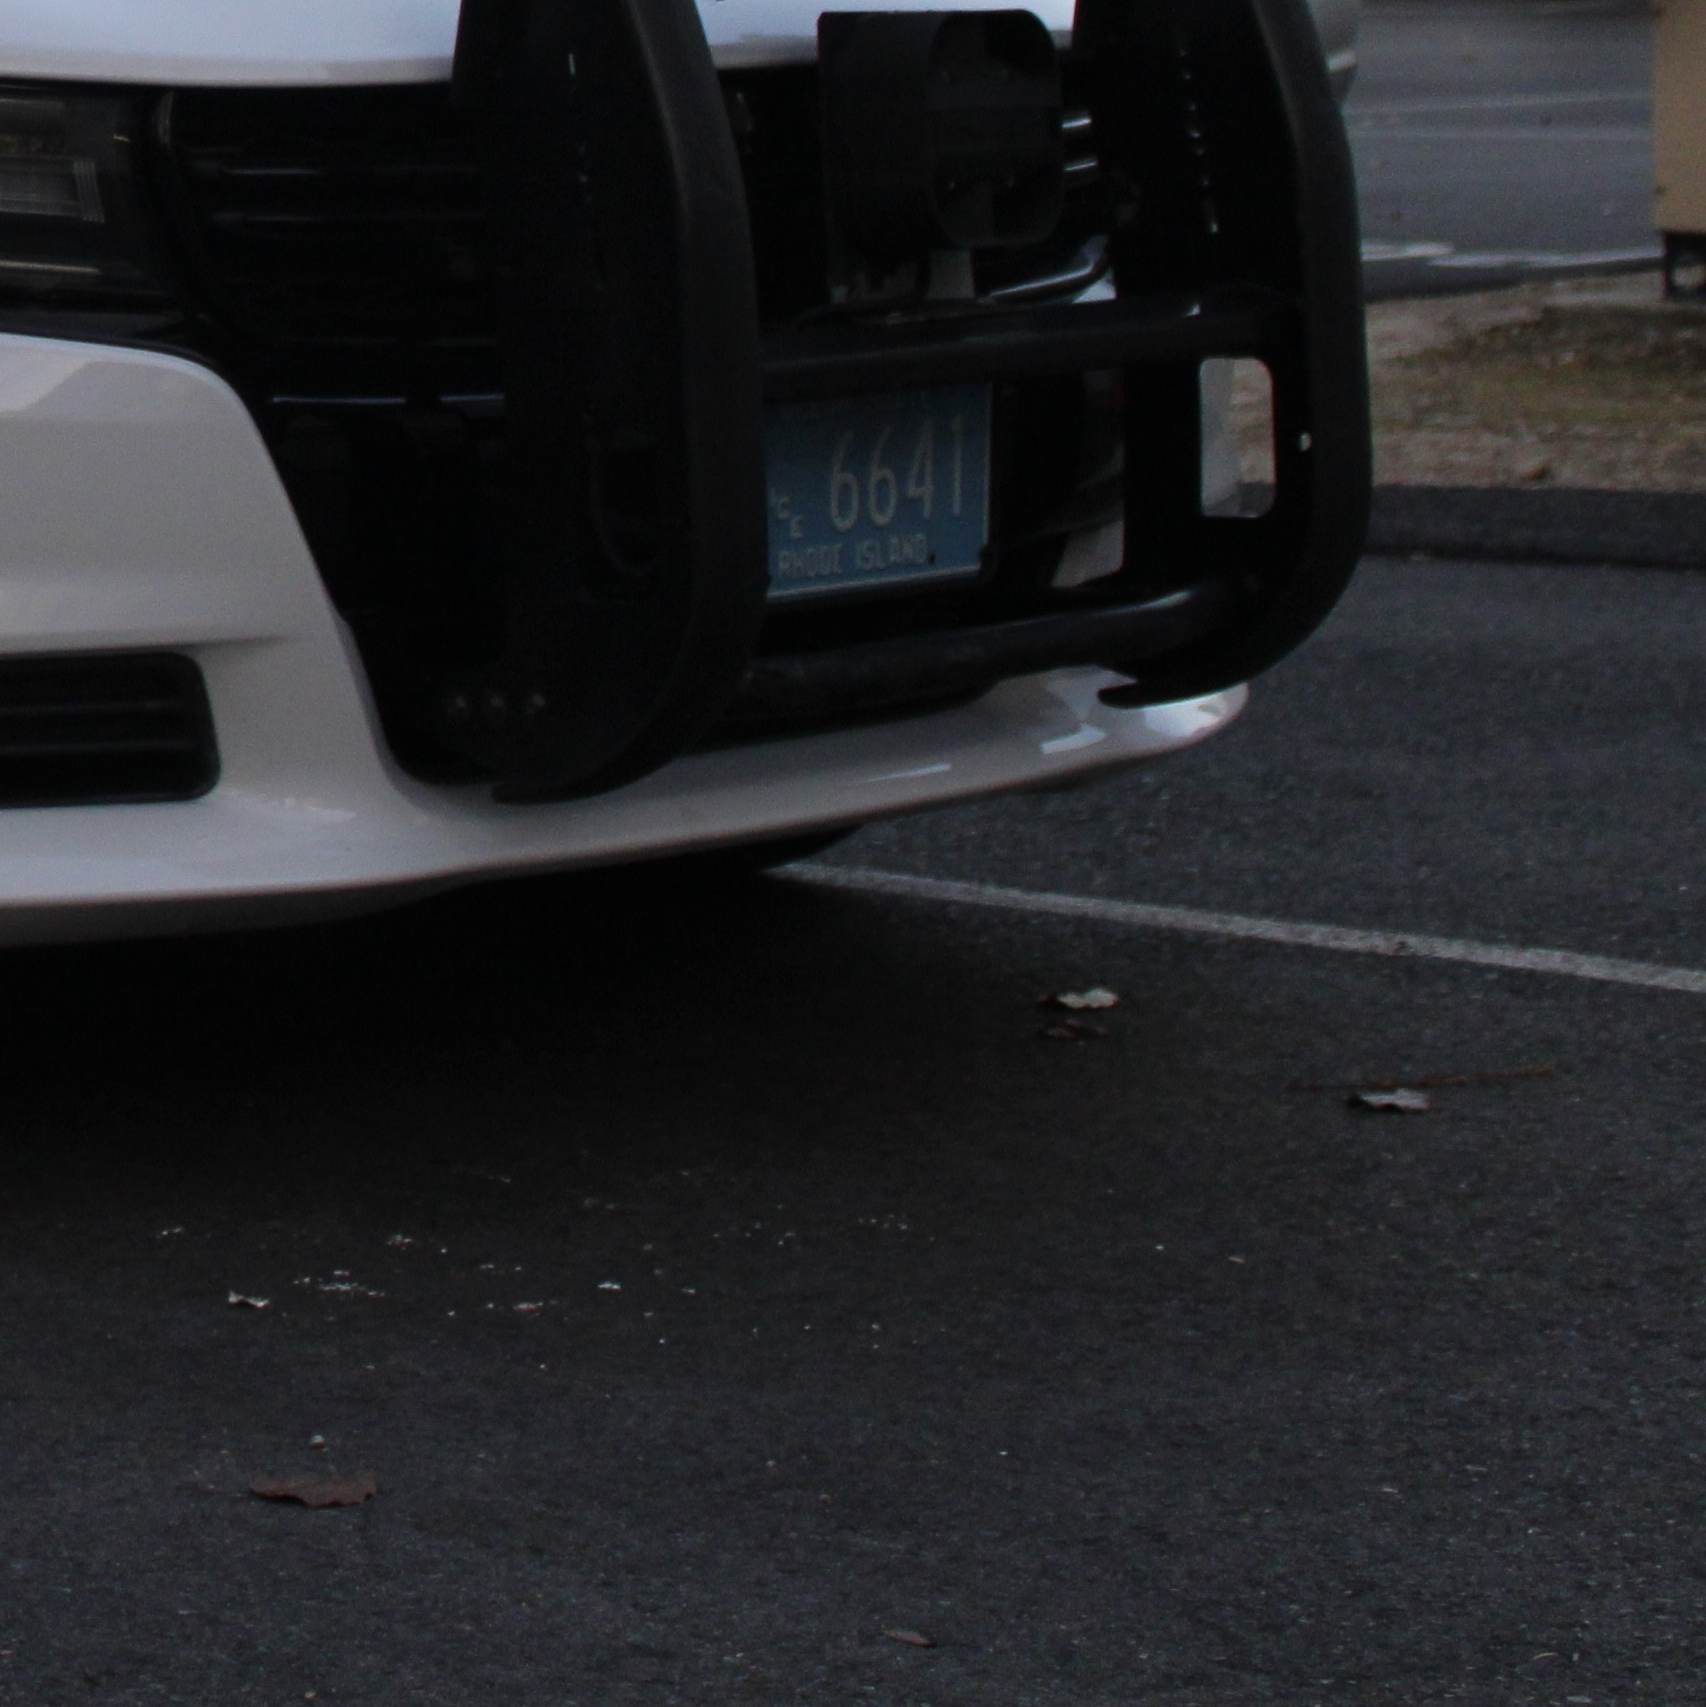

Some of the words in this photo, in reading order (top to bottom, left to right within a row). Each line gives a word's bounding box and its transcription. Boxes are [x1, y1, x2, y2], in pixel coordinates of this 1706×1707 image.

[828, 413, 964, 533] 6641
[777, 543, 844, 579] RHODE
[855, 532, 930, 572] ISLAND
